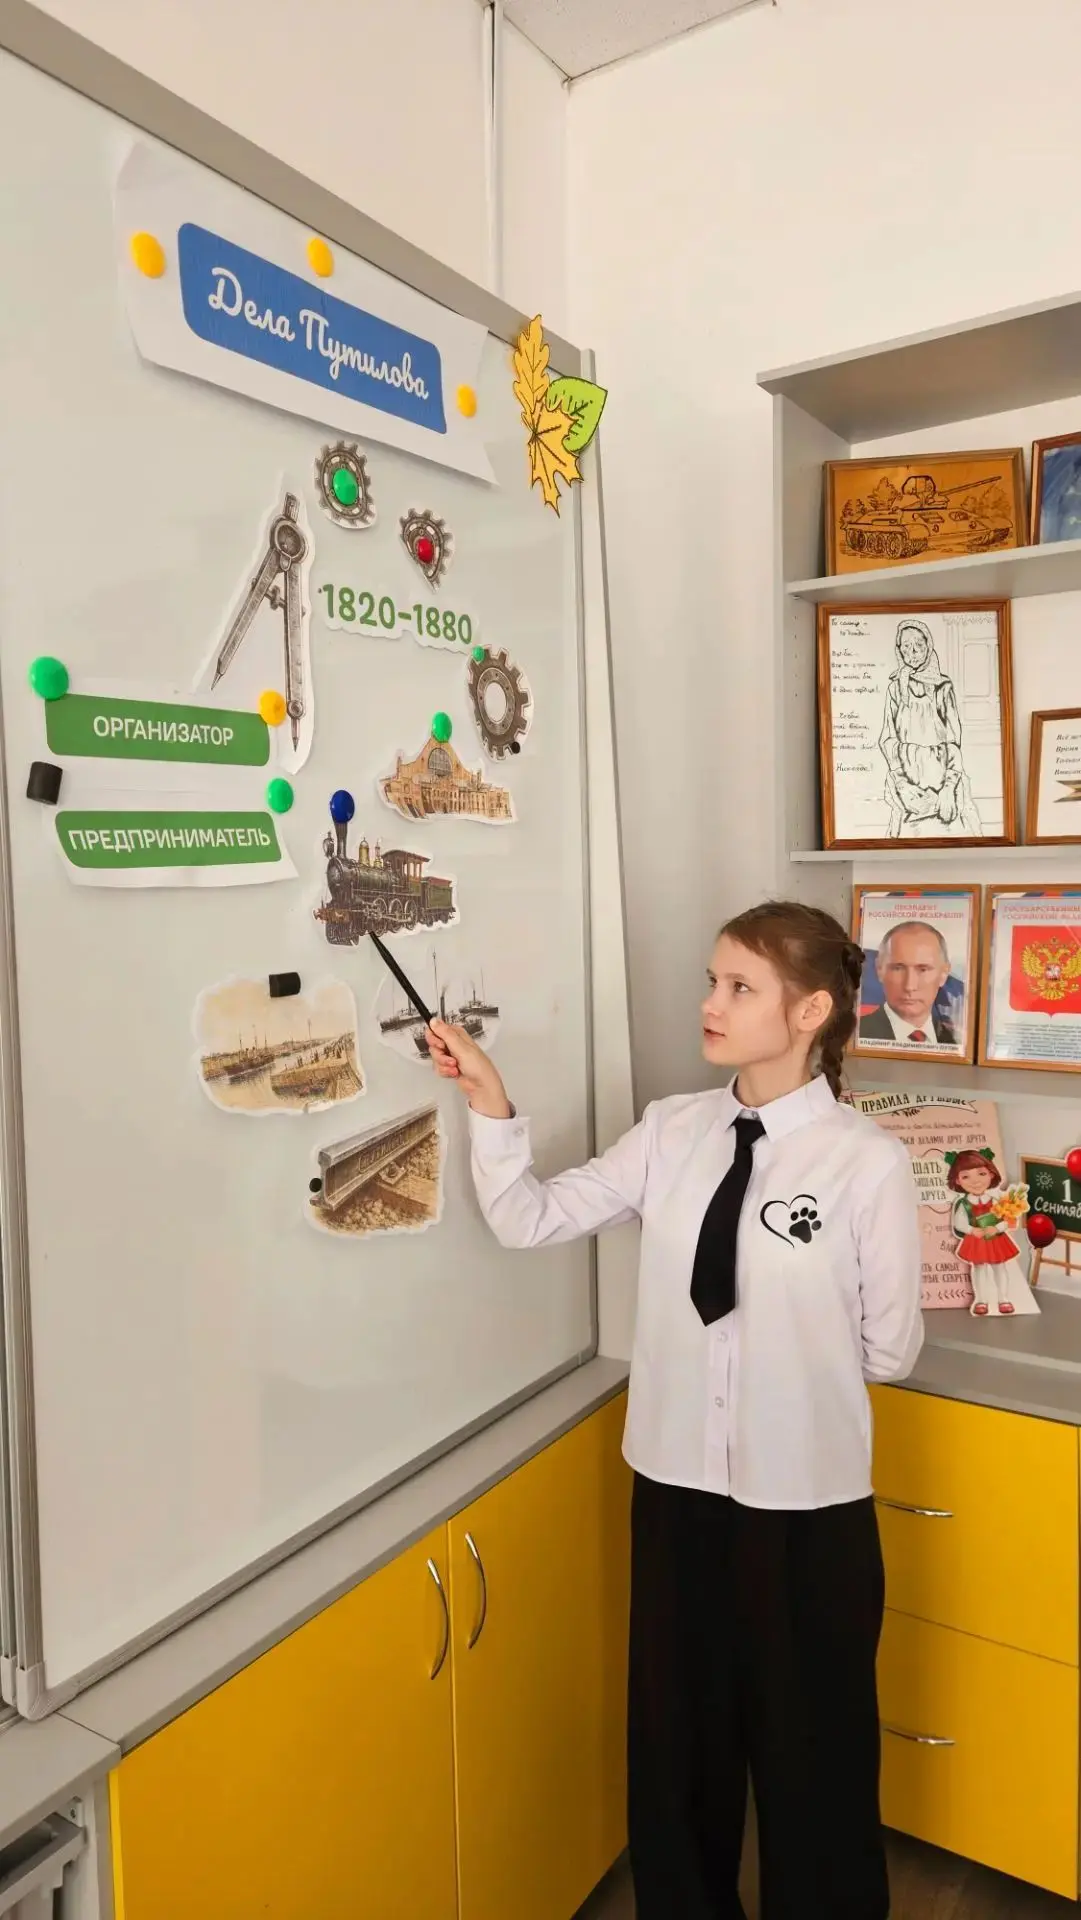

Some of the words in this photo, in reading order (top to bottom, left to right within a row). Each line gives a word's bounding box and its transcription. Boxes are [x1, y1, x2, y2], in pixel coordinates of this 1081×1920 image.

[208, 266, 296, 342] Дела
[299, 308, 430, 400] Путилова
[322, 583, 473, 645] 1820-1880
[92, 715, 235, 747] ОРГАНИЗАТОР
[67, 826, 271, 853] ПРЕДПРИНИМАТЕЛЬ
[868, 911, 917, 919] РОССИЙСКОЙ
[861, 1093, 910, 1113] ПРАВИЛА
[1062, 1179, 1073, 1203] 1
[1034, 1196, 1081, 1218] Сентяб
